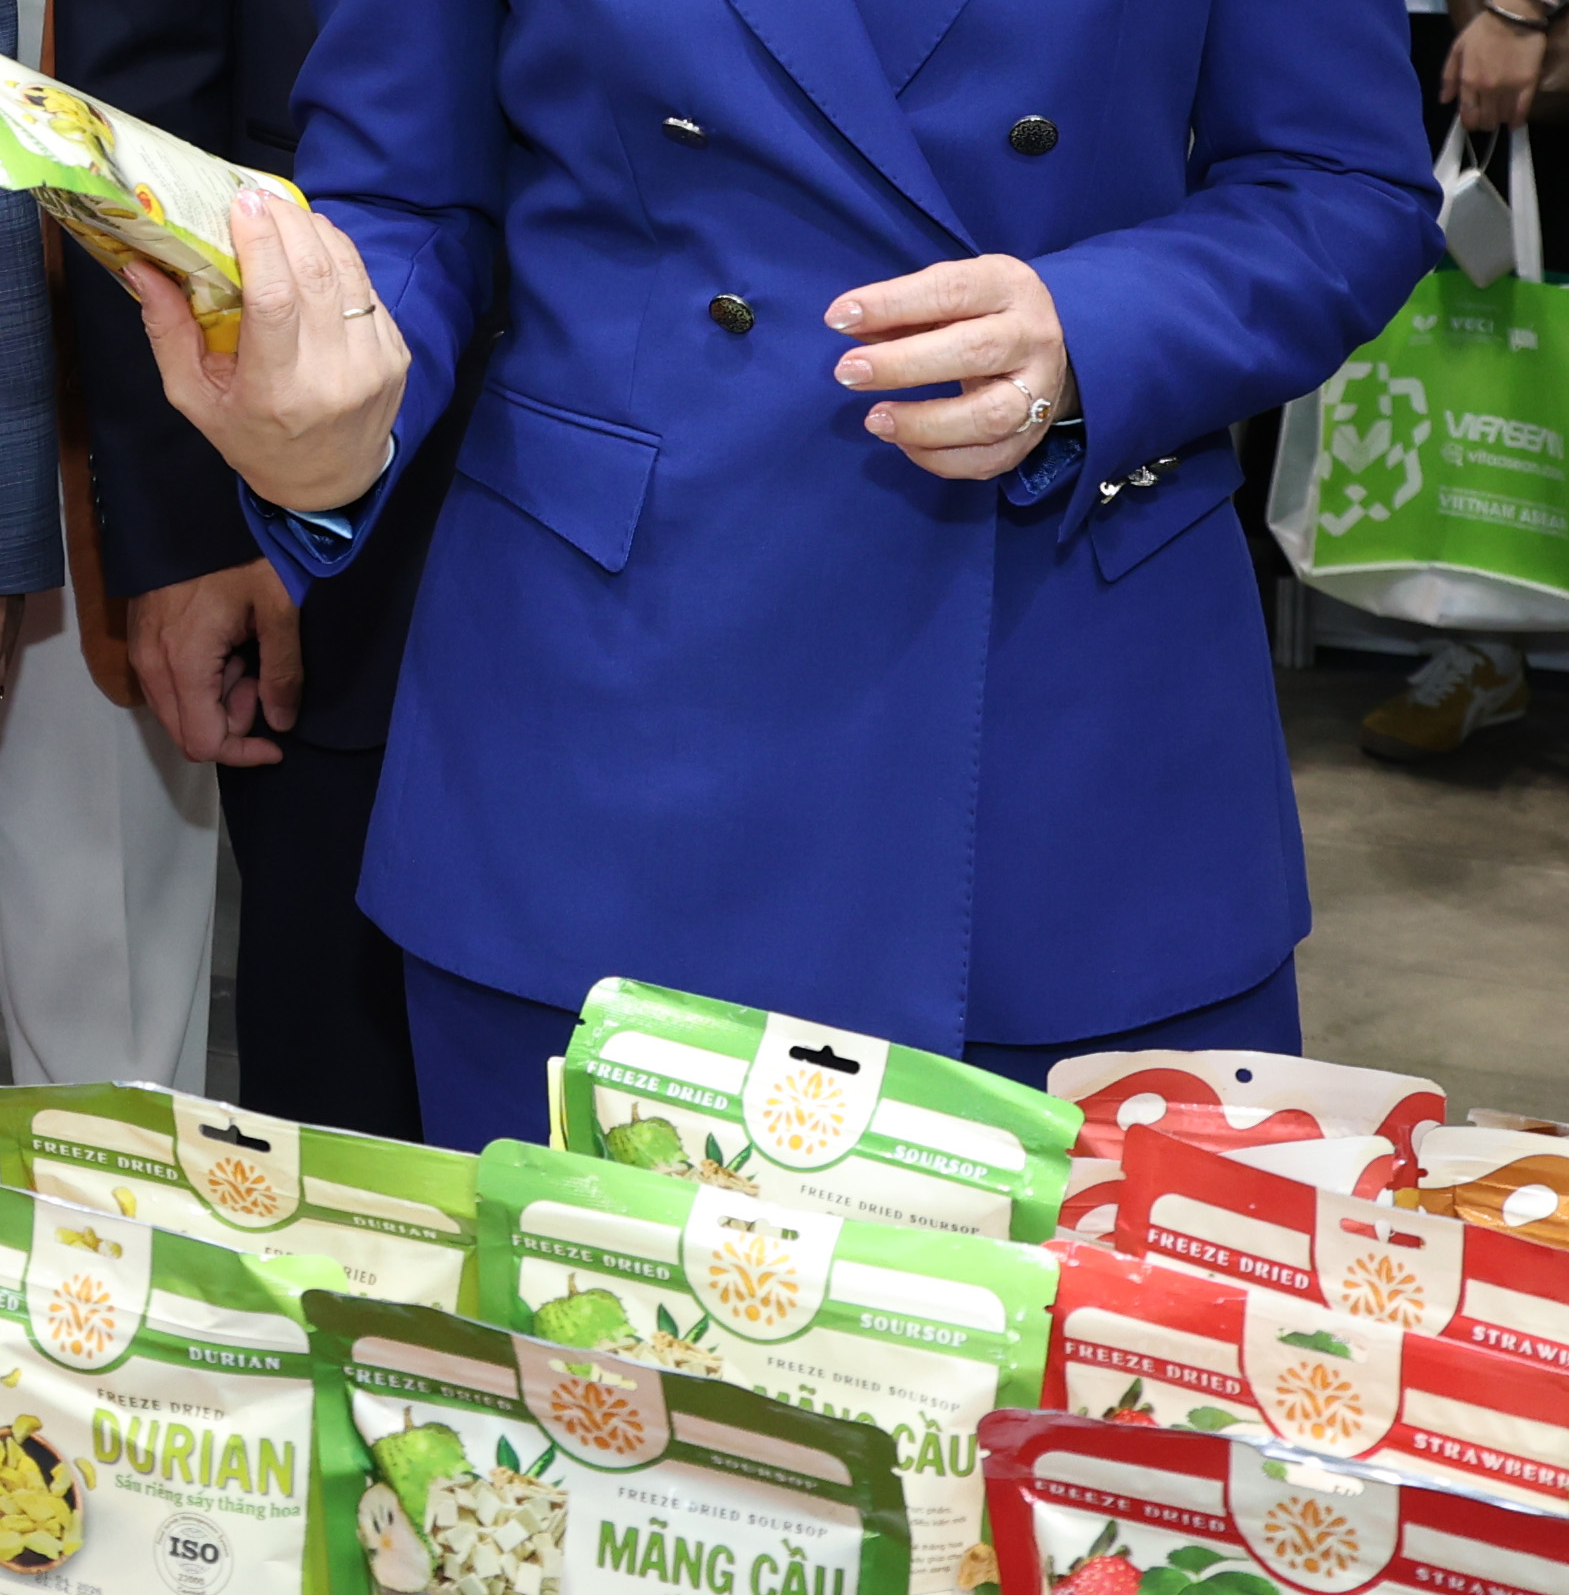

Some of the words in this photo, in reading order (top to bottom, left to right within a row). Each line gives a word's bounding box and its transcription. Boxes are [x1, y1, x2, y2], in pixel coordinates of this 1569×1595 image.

[587, 1060, 660, 1092] FREEZE
[666, 1080, 729, 1111] DRIED
[33, 1138, 108, 1165] FREEZE
[117, 1155, 179, 1181] DRIED
[893, 1143, 989, 1182] SOURSOP
[352, 1215, 438, 1240] DURIAN
[800, 1184, 852, 1208] FREEZE
[858, 1198, 903, 1221] DRIED
[909, 1212, 981, 1236] SOURSOP
[343, 1266, 377, 1286] RIED
[511, 1234, 593, 1264] FREEZE
[603, 1253, 671, 1281] DRIED
[1147, 1228, 1231, 1267] FREEZE
[1239, 1256, 1311, 1290] DRIED
[860, 1312, 968, 1348] SOURSOP
[188, 1345, 282, 1371] DURIAN
[1064, 1341, 1156, 1374] FREEZE
[1166, 1364, 1242, 1395] DRIED
[96, 1387, 162, 1413] FREEZE
[169, 1398, 226, 1421] DRIED
[343, 1365, 431, 1394] FREEZE
[441, 1385, 512, 1411] DRIED
[767, 1356, 825, 1379] FREEZE
[832, 1370, 882, 1394] DRIED
[888, 1384, 961, 1412] SOURSOP
[90, 1407, 296, 1498] DURIAN
[269, 1502, 301, 1518] hoa
[618, 1486, 681, 1511] FREEZE
[687, 1500, 741, 1523] DRIED
[747, 1515, 830, 1540] SOURSOP
[1033, 1478, 1132, 1512] FREEZE
[1143, 1503, 1227, 1533] DRIED
[168, 1535, 220, 1565] ISO
[596, 1517, 735, 1595] MÃNG
[750, 1538, 846, 1595] CẦU
